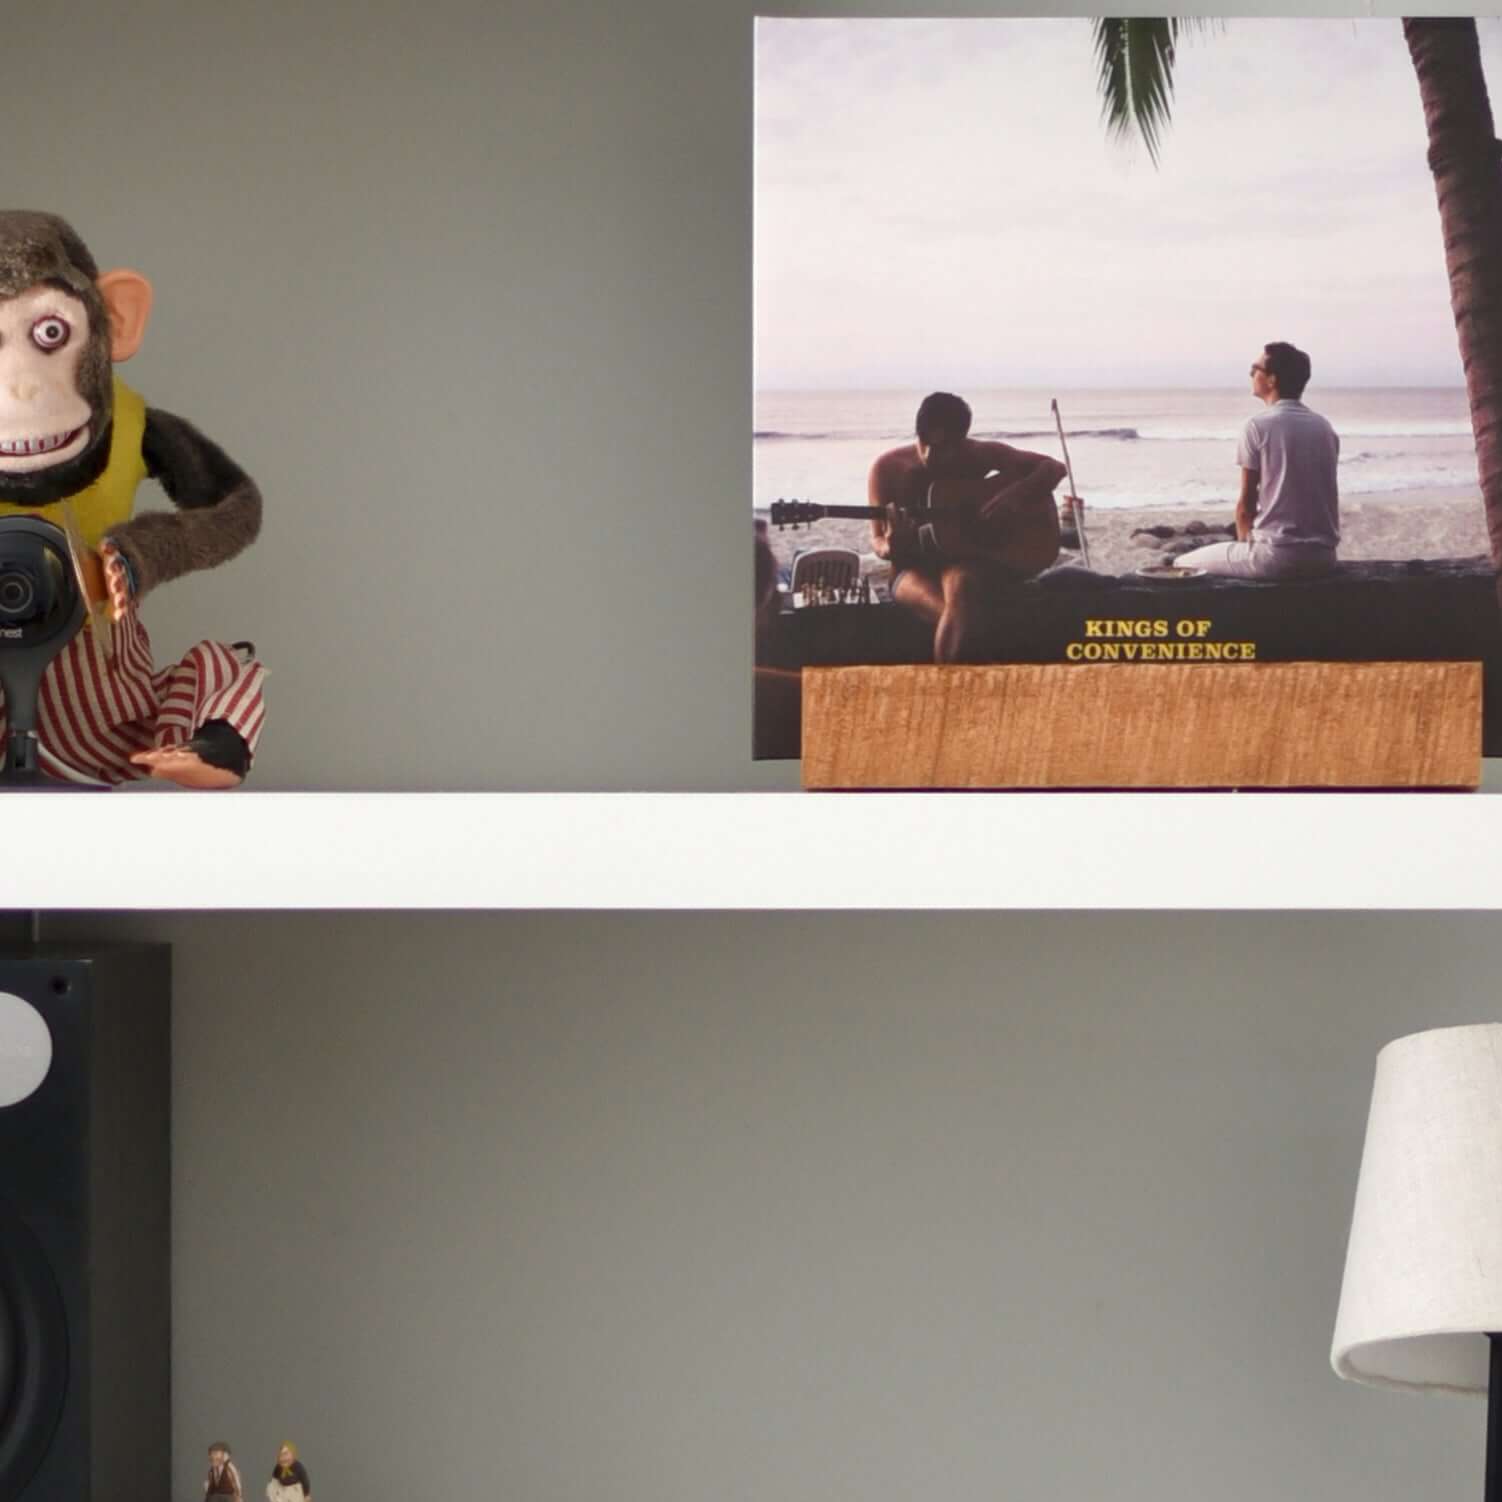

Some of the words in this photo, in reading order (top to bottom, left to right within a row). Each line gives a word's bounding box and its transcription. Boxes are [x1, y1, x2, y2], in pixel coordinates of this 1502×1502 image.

[1085, 620, 1169, 637] KINGS
[1176, 620, 1212, 637] OF
[1066, 643, 1256, 660] CONVENIENCE
